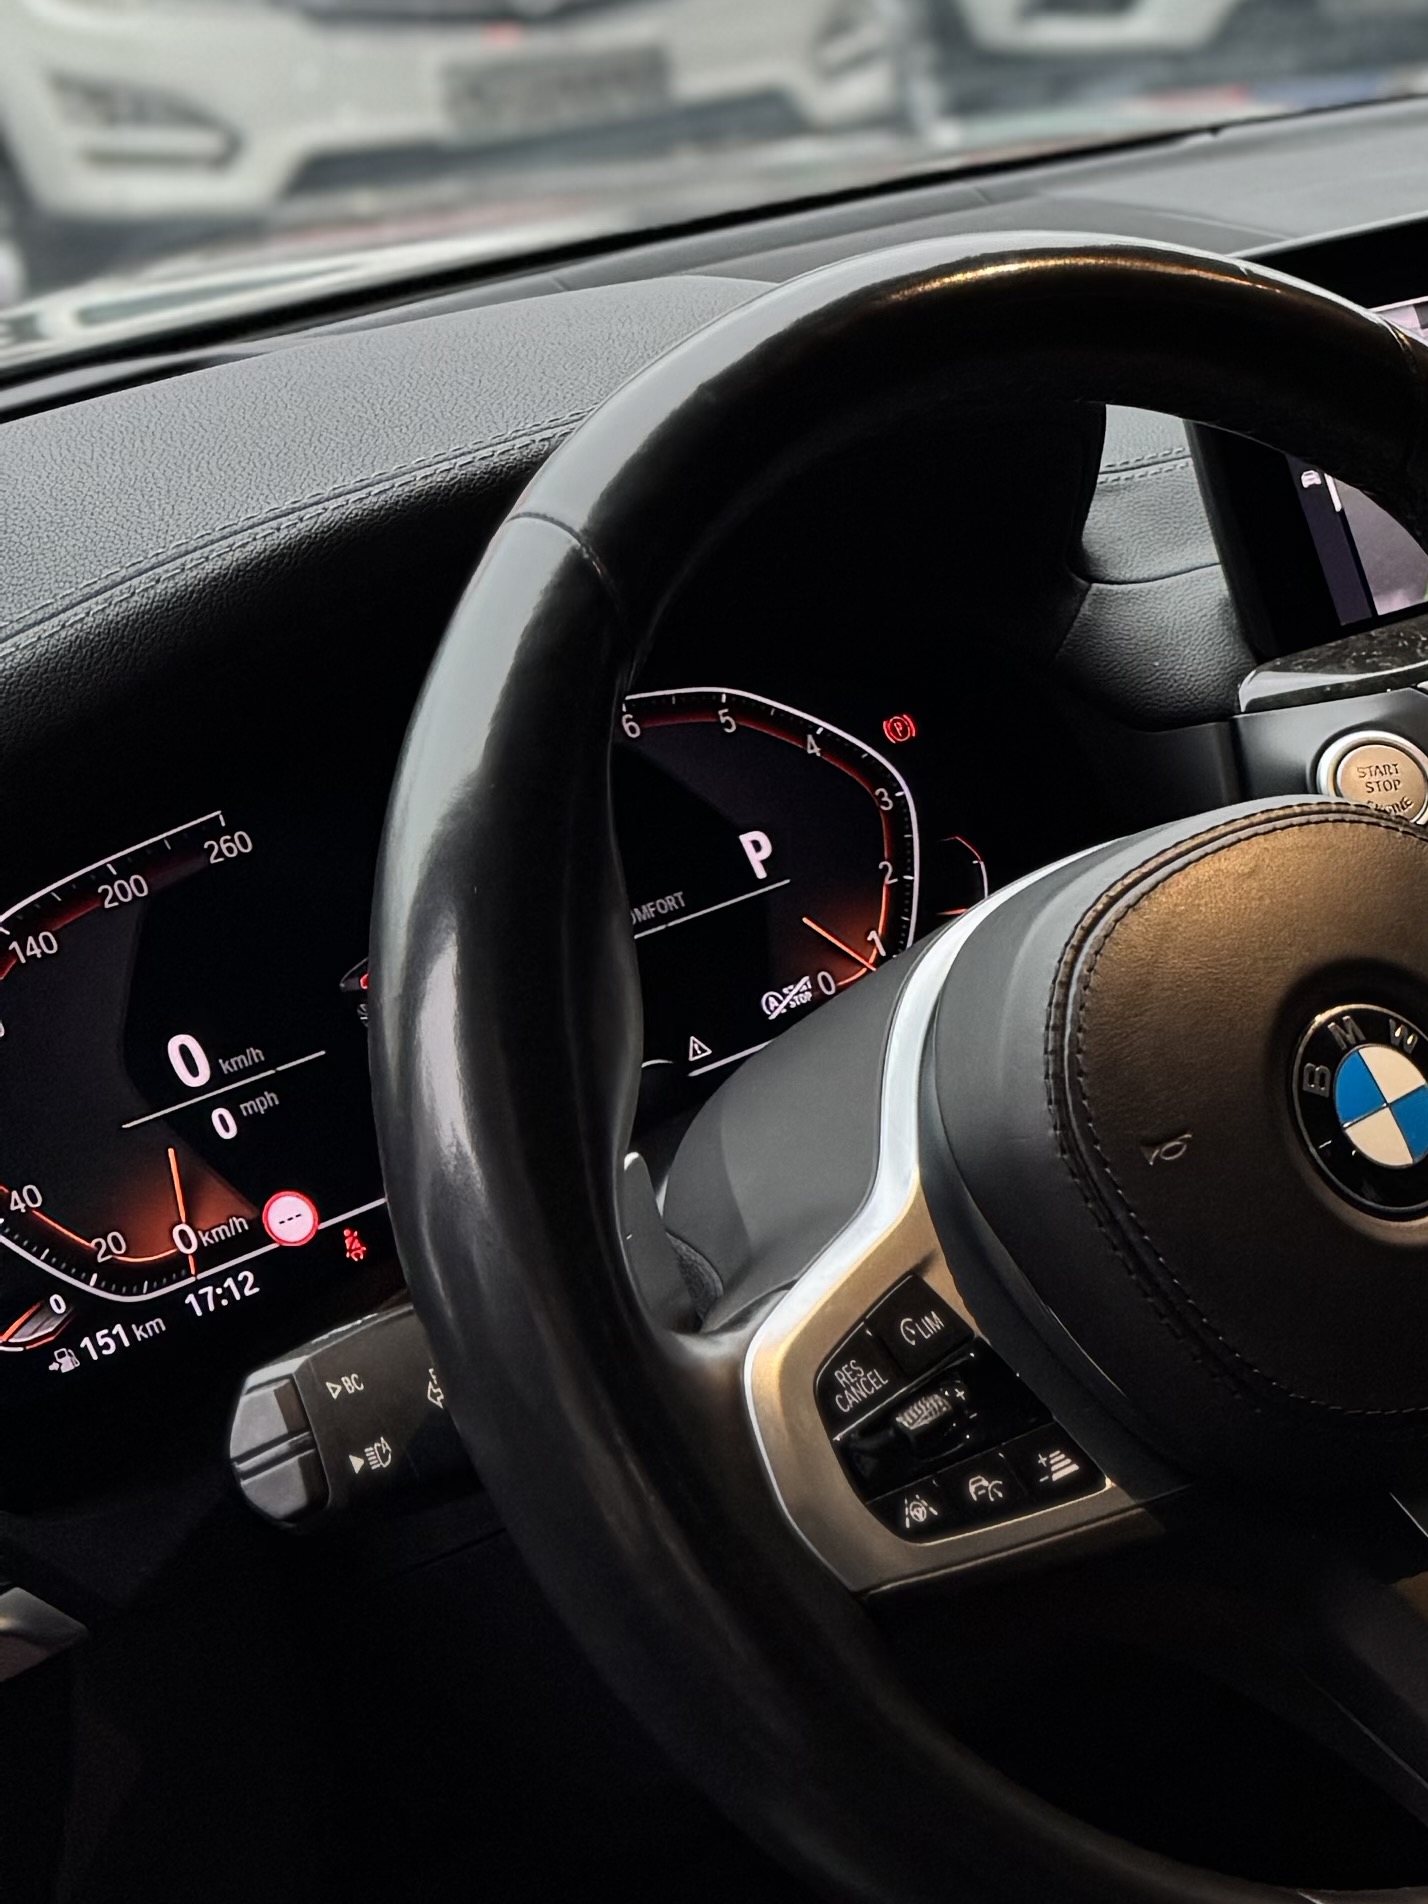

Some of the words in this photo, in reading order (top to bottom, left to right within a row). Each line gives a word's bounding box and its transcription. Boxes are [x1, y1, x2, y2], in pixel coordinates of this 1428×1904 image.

[621, 713, 641, 739] 6
[717, 708, 737, 734] 5
[805, 734, 822, 757] 4
[1356, 762, 1400, 779] START
[874, 787, 894, 811] 3
[1365, 778, 1402, 794] STOP
[203, 830, 253, 864] 260
[738, 830, 773, 880] P
[878, 861, 899, 885] 2
[97, 874, 149, 909] 200
[8, 930, 59, 964] 140
[866, 930, 887, 957] 1
[816, 971, 837, 996] 0
[788, 990, 813, 1008] STOP
[167, 1033, 211, 1088] 0
[218, 1047, 266, 1075] km/h
[1302, 1014, 1418, 1099] BMW
[211, 1107, 239, 1140] 0
[239, 1091, 280, 1118] mph
[9, 1184, 43, 1213] 40
[93, 1230, 127, 1263] 20
[172, 1224, 199, 1255] 0
[198, 1215, 250, 1248] km/h
[49, 1293, 67, 1315] 0
[184, 1269, 261, 1317] 17:12
[79, 1323, 131, 1362] 151
[131, 1316, 167, 1343] km
[916, 1310, 945, 1339] LIM
[341, 1373, 364, 1394] BC
[834, 1360, 865, 1389] RES
[834, 1368, 889, 1413] CANCEL
